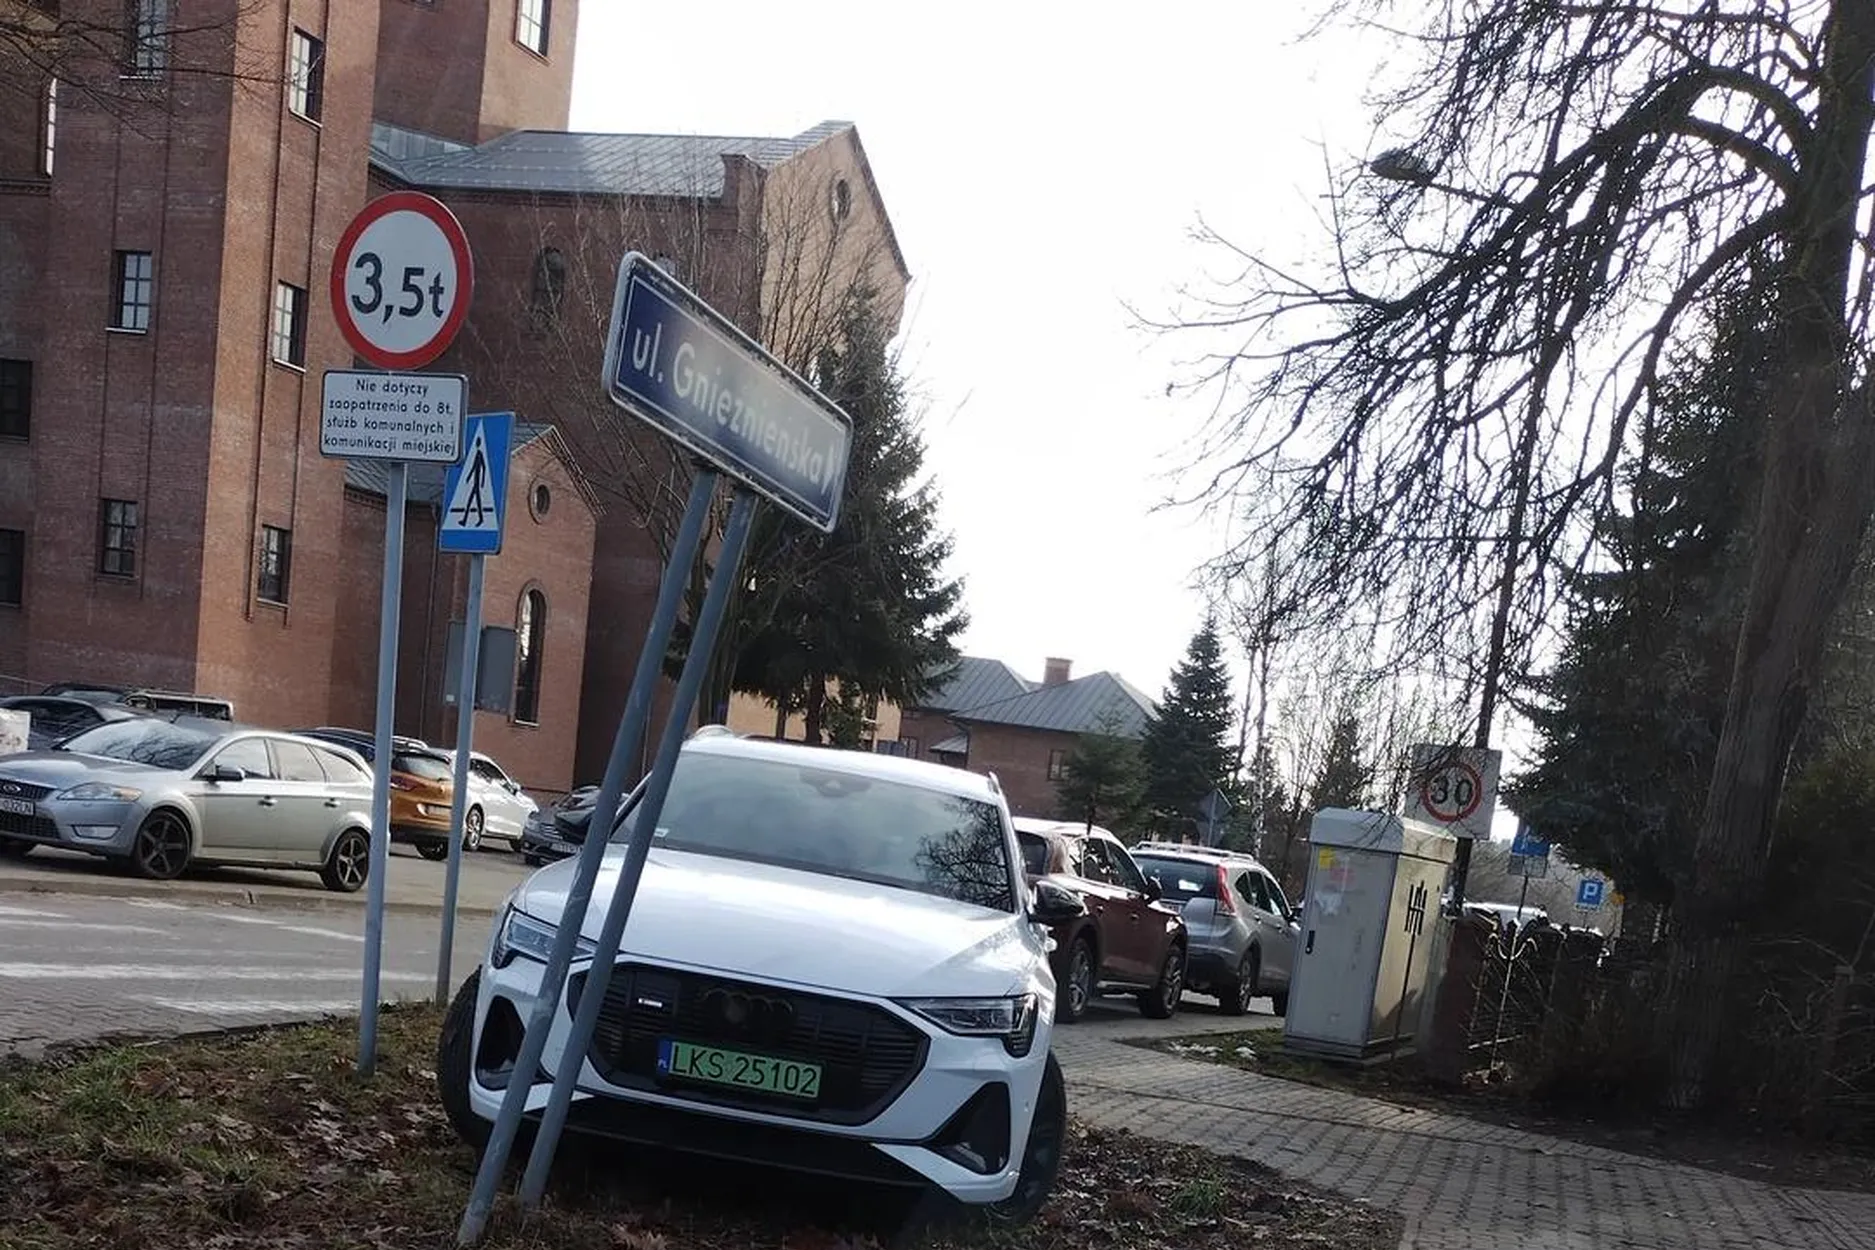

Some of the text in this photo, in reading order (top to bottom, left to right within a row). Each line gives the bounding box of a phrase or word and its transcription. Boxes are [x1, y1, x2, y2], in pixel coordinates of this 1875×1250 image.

[352, 252, 445, 323] 3,5t
[633, 322, 664, 384] ul.
[355, 379, 429, 397] Nie dotyczy
[329, 400, 407, 412] zaopatrzenia
[414, 402, 430, 414] do
[364, 417, 444, 436] komunalnych
[324, 435, 456, 456] komunikacji miejskiej
[1430, 775, 1473, 806] 30
[1583, 882, 1599, 900] P
[672, 1045, 818, 1096] LKS 25102
